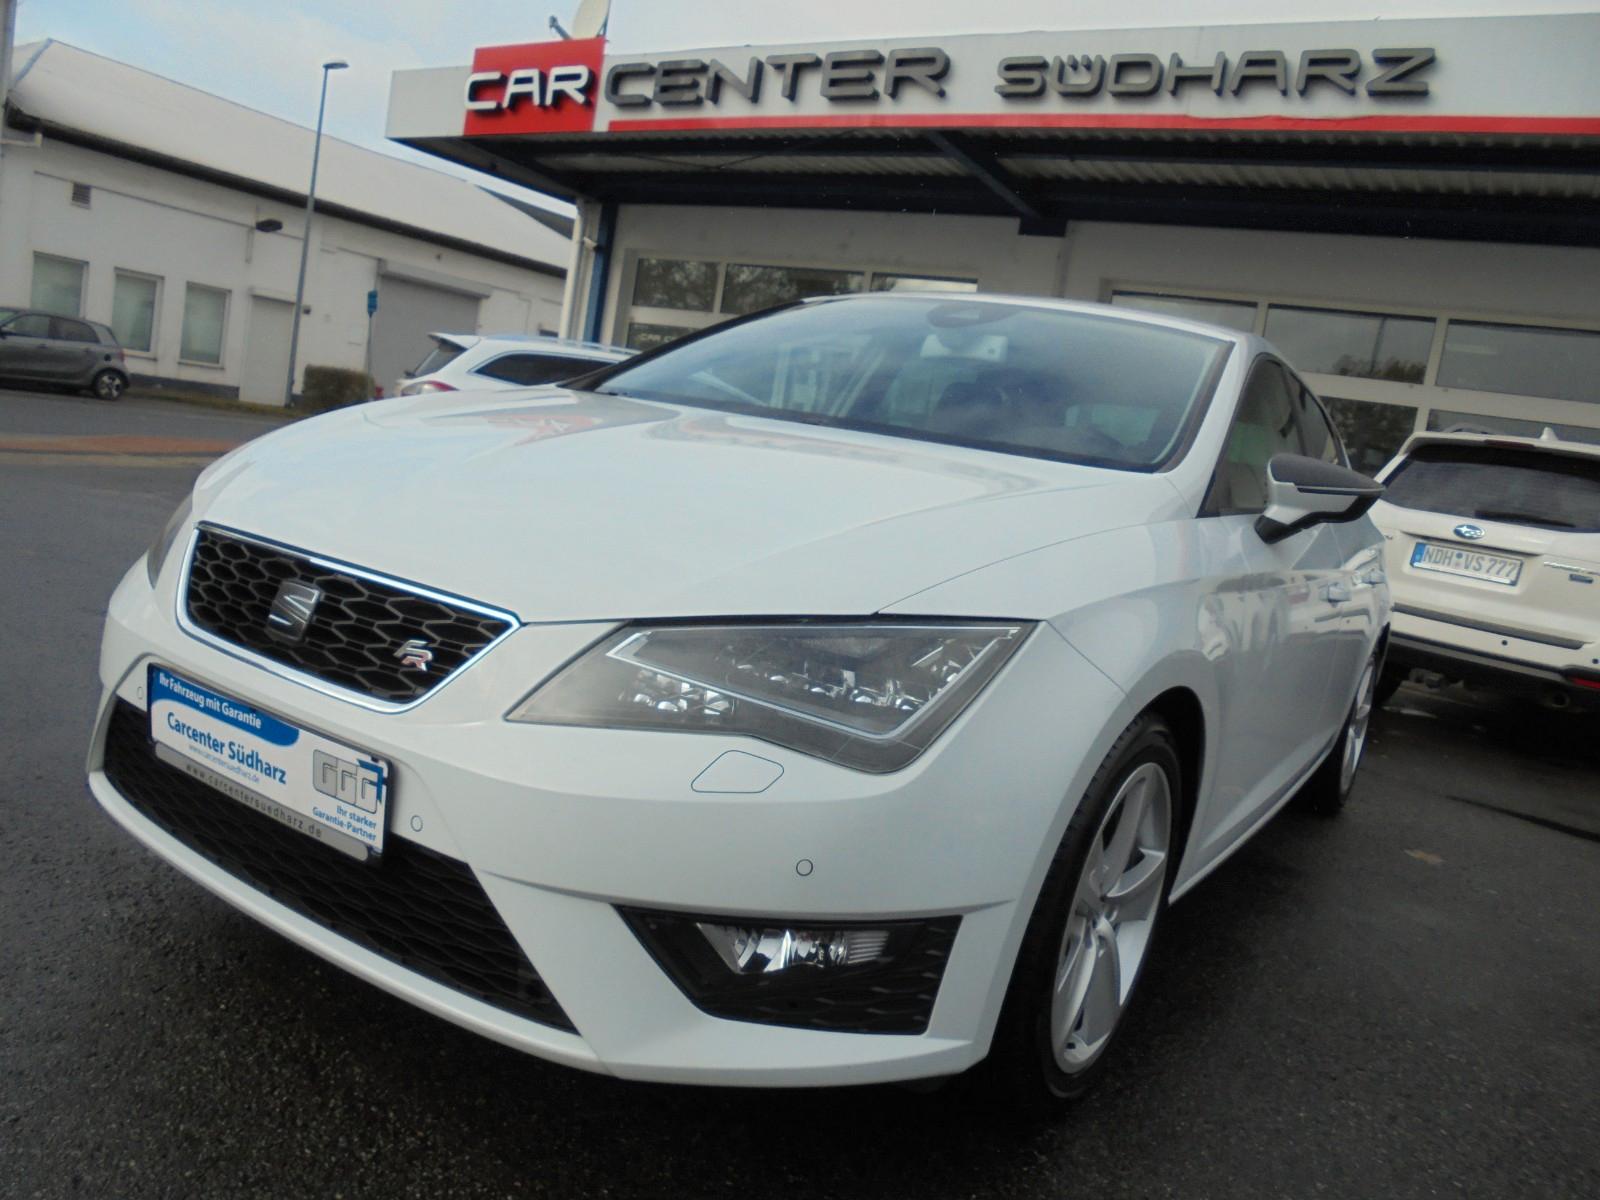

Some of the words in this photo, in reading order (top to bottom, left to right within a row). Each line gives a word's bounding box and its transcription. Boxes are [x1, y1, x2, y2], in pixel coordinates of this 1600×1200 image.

[464, 64, 592, 113] CAR
[604, 47, 950, 106] CENTER
[994, 47, 1436, 98] SÜDHARZ
[1423, 547, 1453, 565] NDH
[1464, 554, 1485, 573] VS
[1486, 558, 1516, 578] 777
[159, 672, 170, 688] Ihr
[169, 678, 205, 707] Fahrzeug
[205, 697, 221, 713] mit
[221, 702, 262, 729] Garantie
[167, 711, 226, 755] Carcenter
[228, 741, 287, 785] Südharz
[312, 806, 377, 842] Garantie-Partner
[336, 805, 348, 819] Ihr
[349, 811, 377, 830] starker
